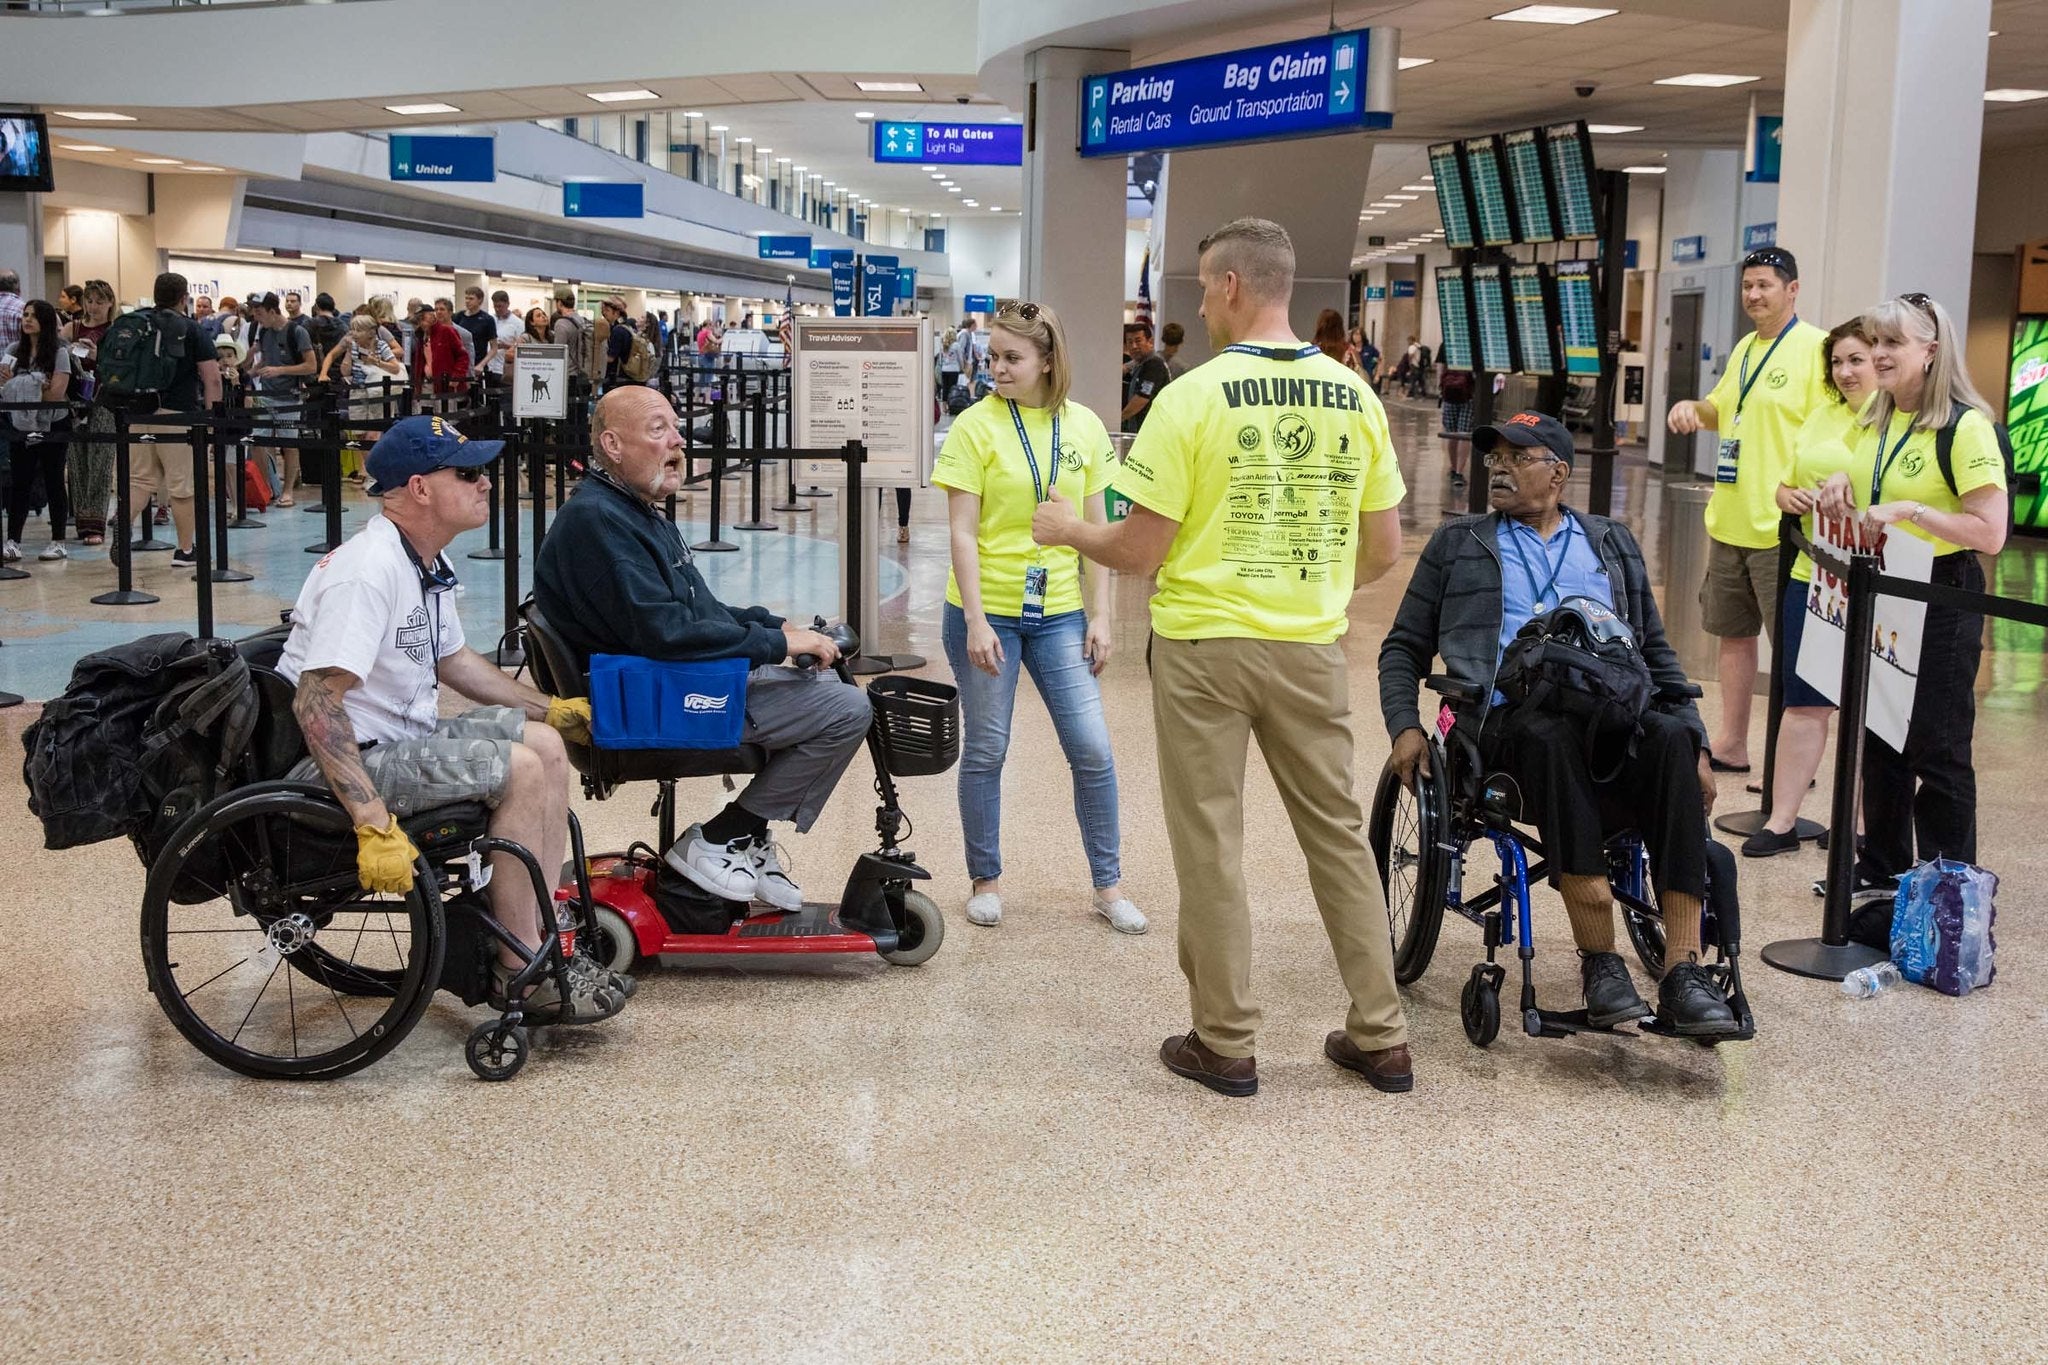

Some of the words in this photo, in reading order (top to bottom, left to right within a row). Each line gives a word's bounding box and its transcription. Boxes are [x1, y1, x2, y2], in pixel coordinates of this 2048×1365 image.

[1223, 63, 1262, 91] Bag
[1268, 51, 1327, 82] Claim
[1111, 76, 1175, 105] Parking
[1189, 101, 1232, 125] Ground
[1236, 90, 1324, 119] Transportation
[1110, 112, 1144, 135] Rental
[1146, 111, 1172, 131] Cars
[927, 128, 939, 139] To
[943, 128, 959, 139] All
[962, 129, 994, 140] Gates
[926, 143, 946, 155] Light
[948, 144, 965, 154] Rail
[415, 164, 453, 175] United
[834, 278, 851, 286] Enter
[867, 284, 882, 312] TSA
[808, 334, 830, 343] Travel
[831, 334, 863, 343] Advisory
[1222, 378, 1364, 413] VOLUNTEER
[1230, 511, 1265, 520] TOYOTA
[1273, 510, 1308, 519] permobil
